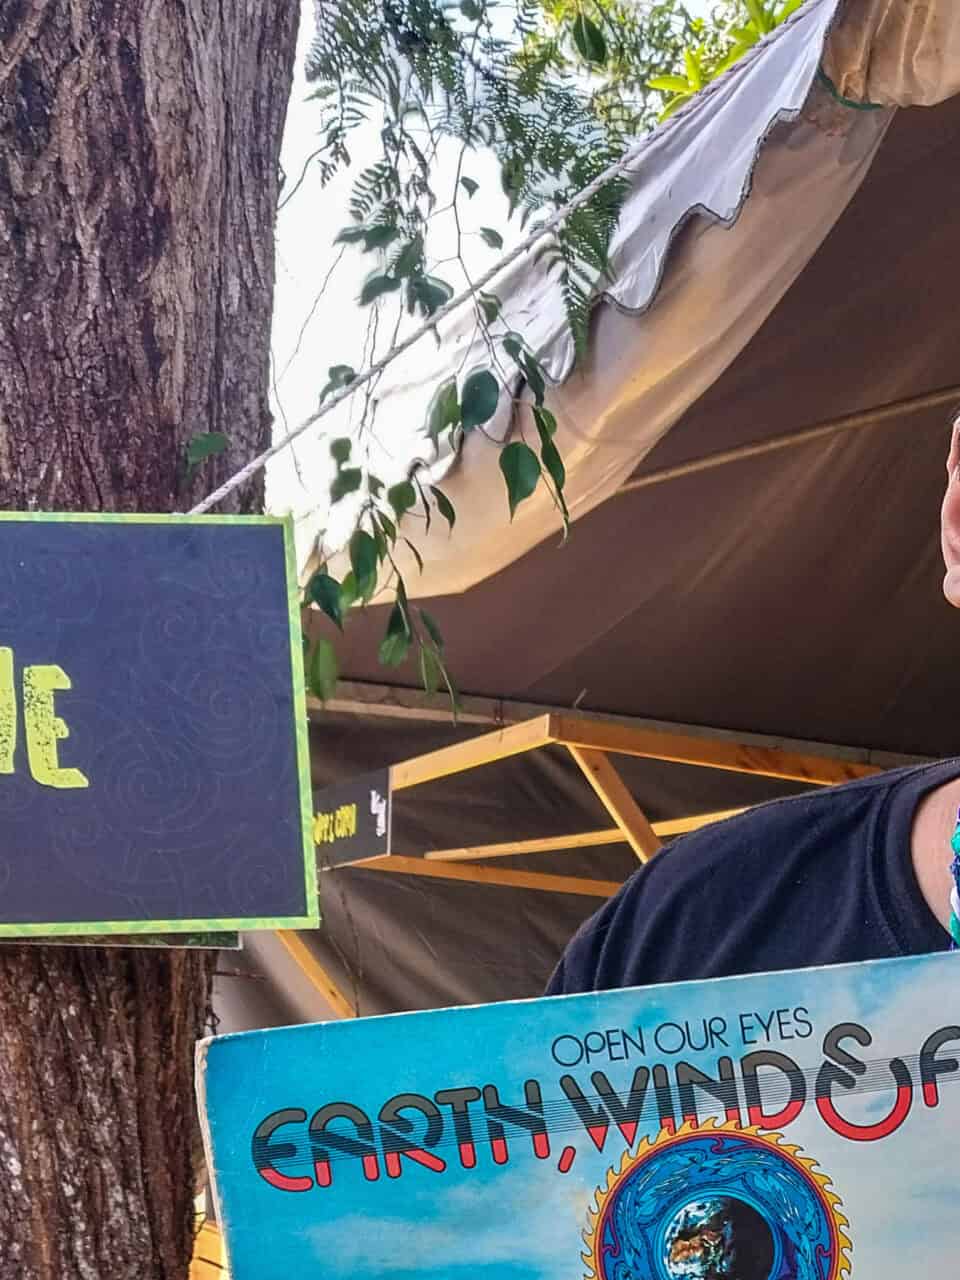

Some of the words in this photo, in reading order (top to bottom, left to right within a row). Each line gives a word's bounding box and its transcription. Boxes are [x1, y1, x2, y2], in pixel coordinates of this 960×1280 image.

[551, 1026, 645, 1066] OPEN
[654, 1016, 728, 1054] OUR
[739, 1007, 813, 1045] EYES
[559, 1050, 807, 1154] WIND
[815, 1022, 912, 1142] &
